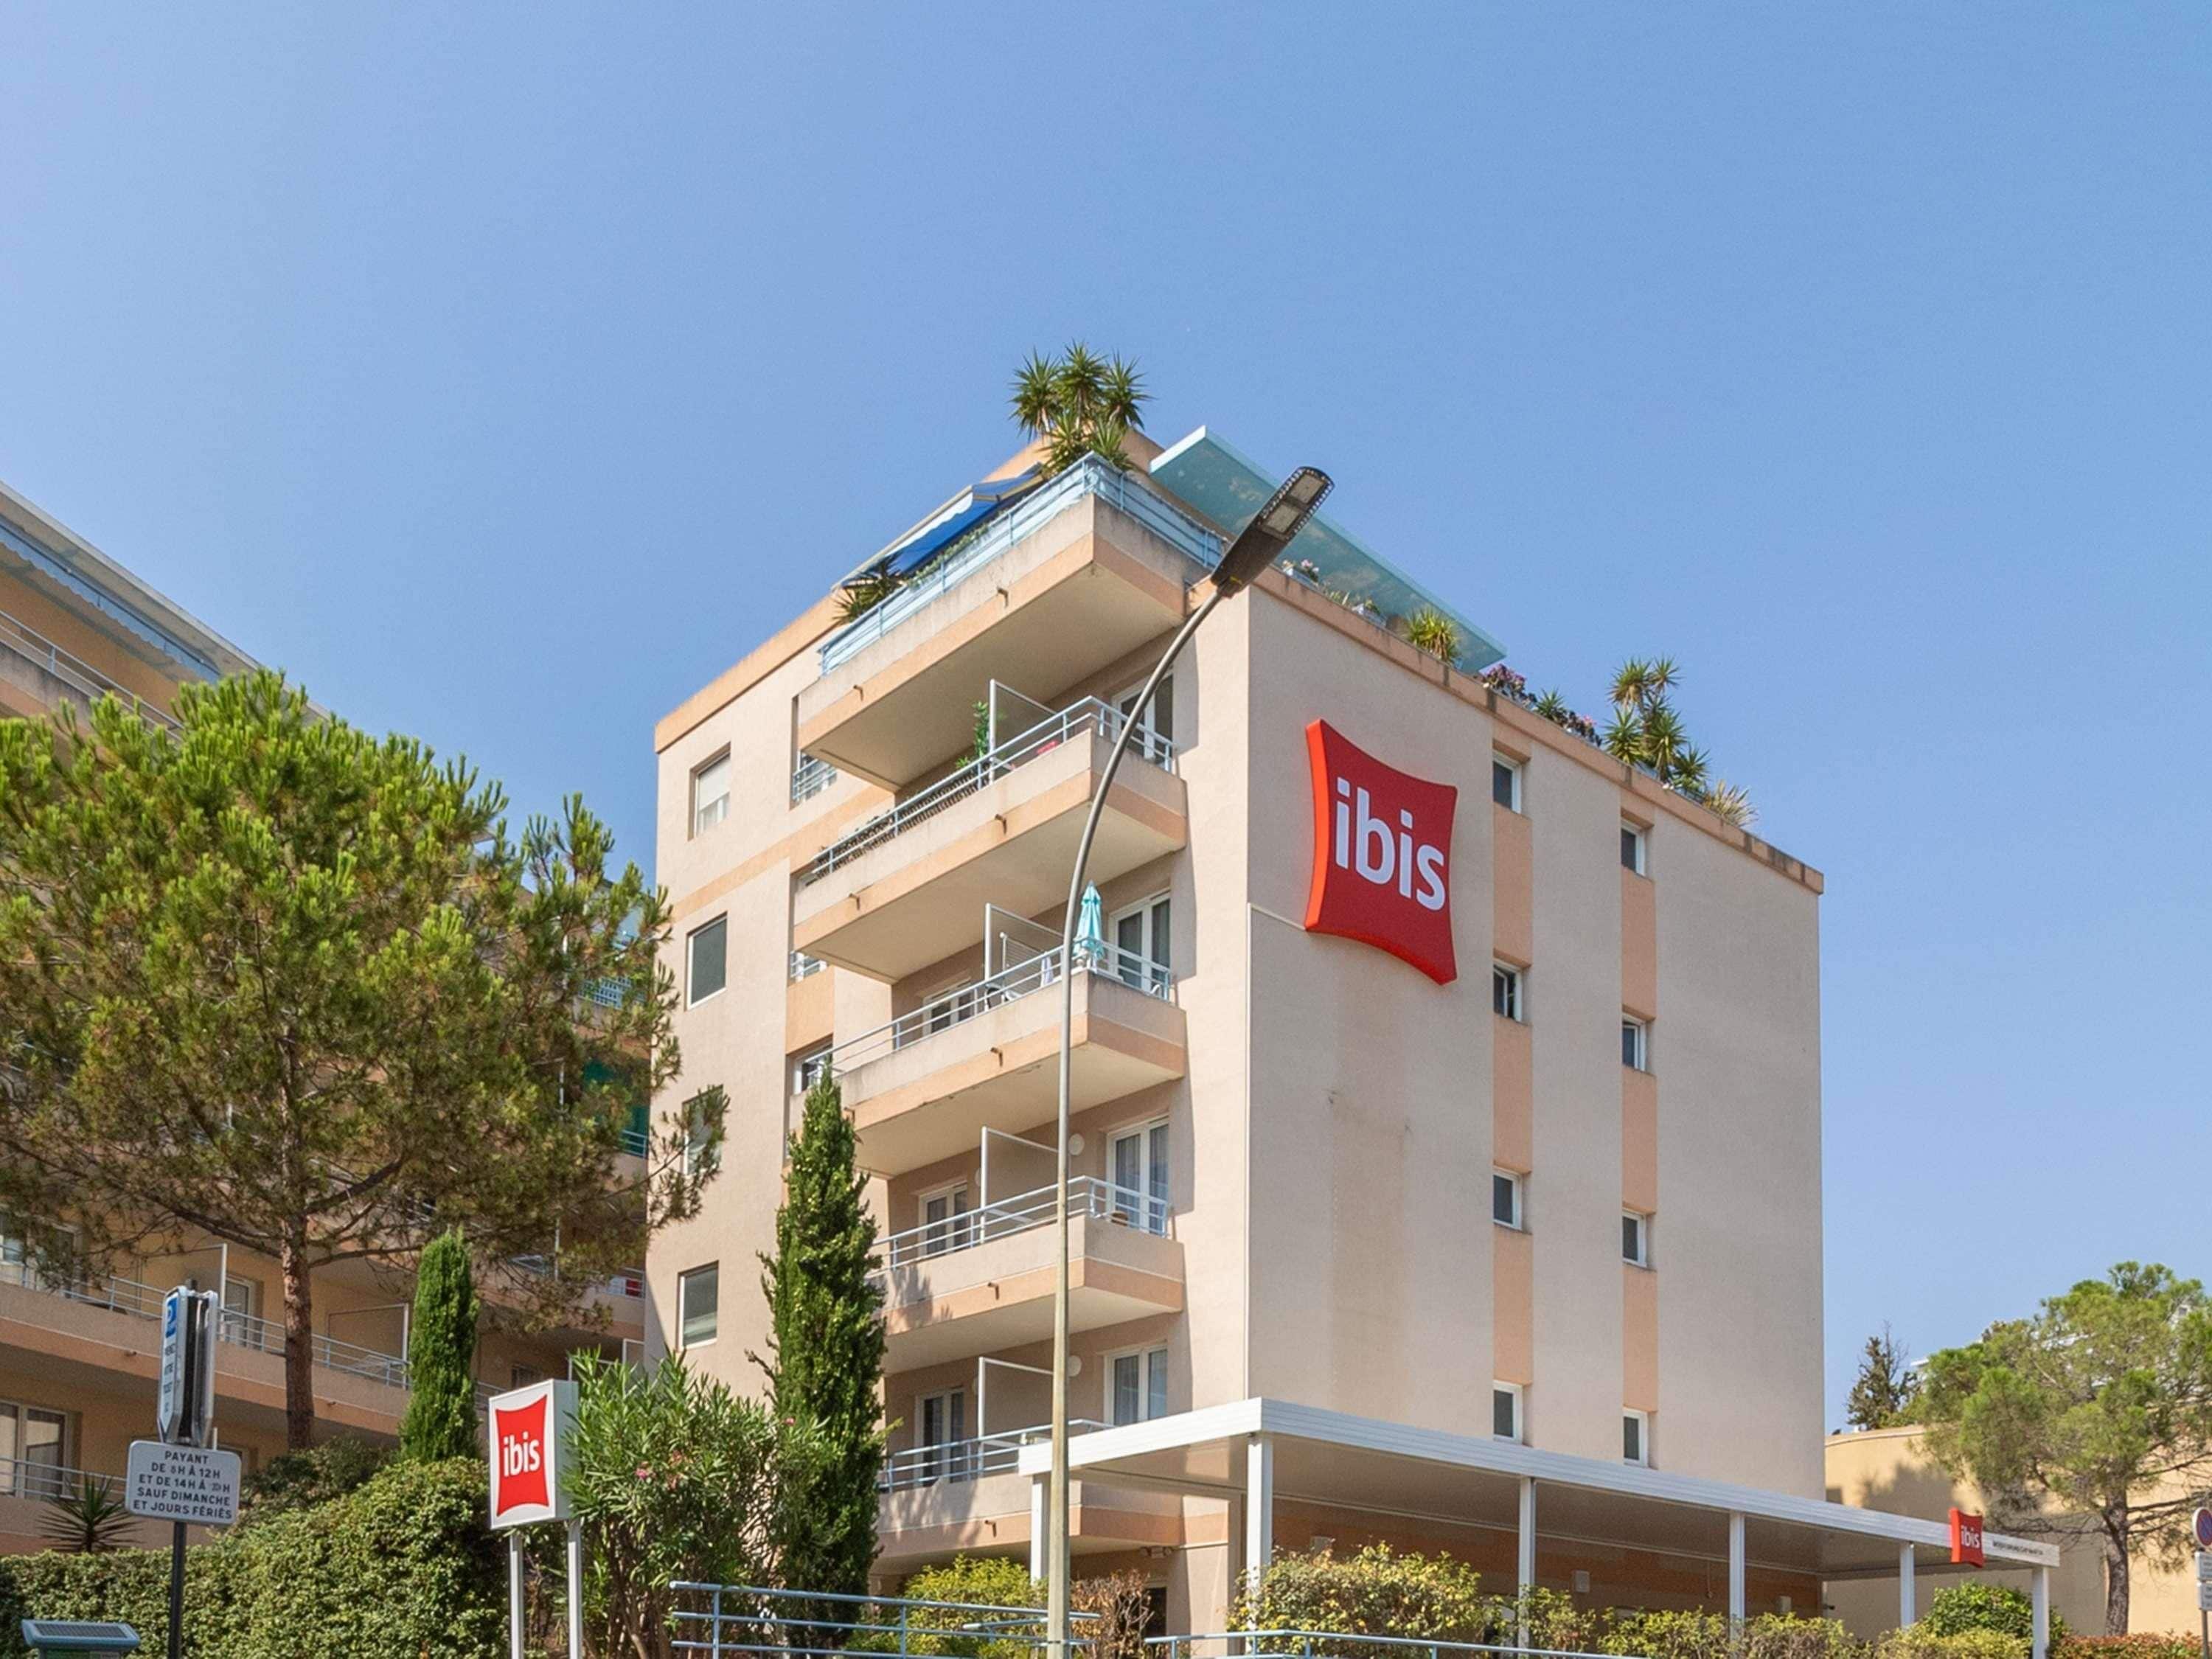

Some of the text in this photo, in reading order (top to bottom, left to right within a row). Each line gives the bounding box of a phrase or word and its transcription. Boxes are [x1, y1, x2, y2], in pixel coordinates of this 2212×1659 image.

[1335, 777, 1446, 911] ibis
[165, 1450, 209, 1464] PAYANT
[504, 1431, 540, 1477] ibis
[151, 1462, 166, 1472] DE
[199, 1468, 220, 1478] 12H
[139, 1474, 153, 1484] ET
[156, 1476, 171, 1486] DE
[175, 1478, 195, 1489] 14H
[137, 1486, 230, 1506] SAUF DIMANCHE
[133, 1500, 232, 1519] ET JOURS FÉRIÉS
[1961, 1525, 1980, 1548] ibis
